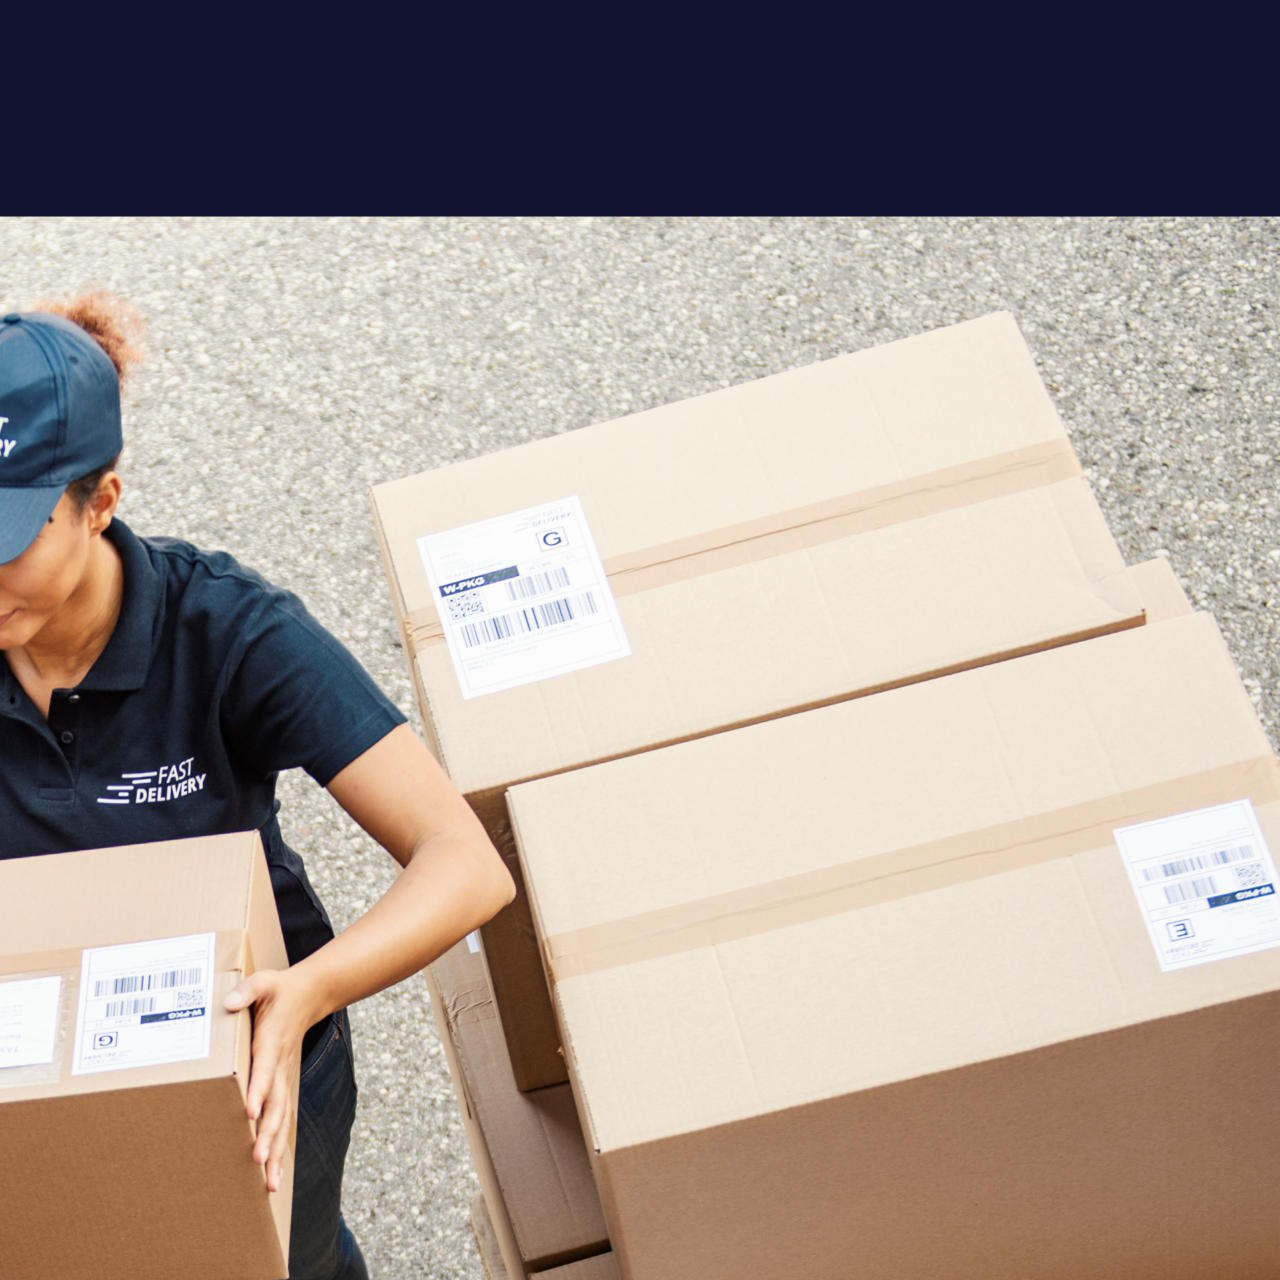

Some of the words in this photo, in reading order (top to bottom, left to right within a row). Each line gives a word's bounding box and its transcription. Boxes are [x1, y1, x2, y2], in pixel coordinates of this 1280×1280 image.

[542, 506, 563, 517] FAST
[532, 512, 571, 527] DELIVERY
[543, 532, 562, 546] G
[443, 576, 485, 594] W-PKG
[158, 757, 195, 784] FAST
[135, 773, 207, 803] DELIVERY
[1173, 923, 1188, 937] E
[168, 1008, 202, 1019] W-PKG
[99, 1035, 113, 1046] G
